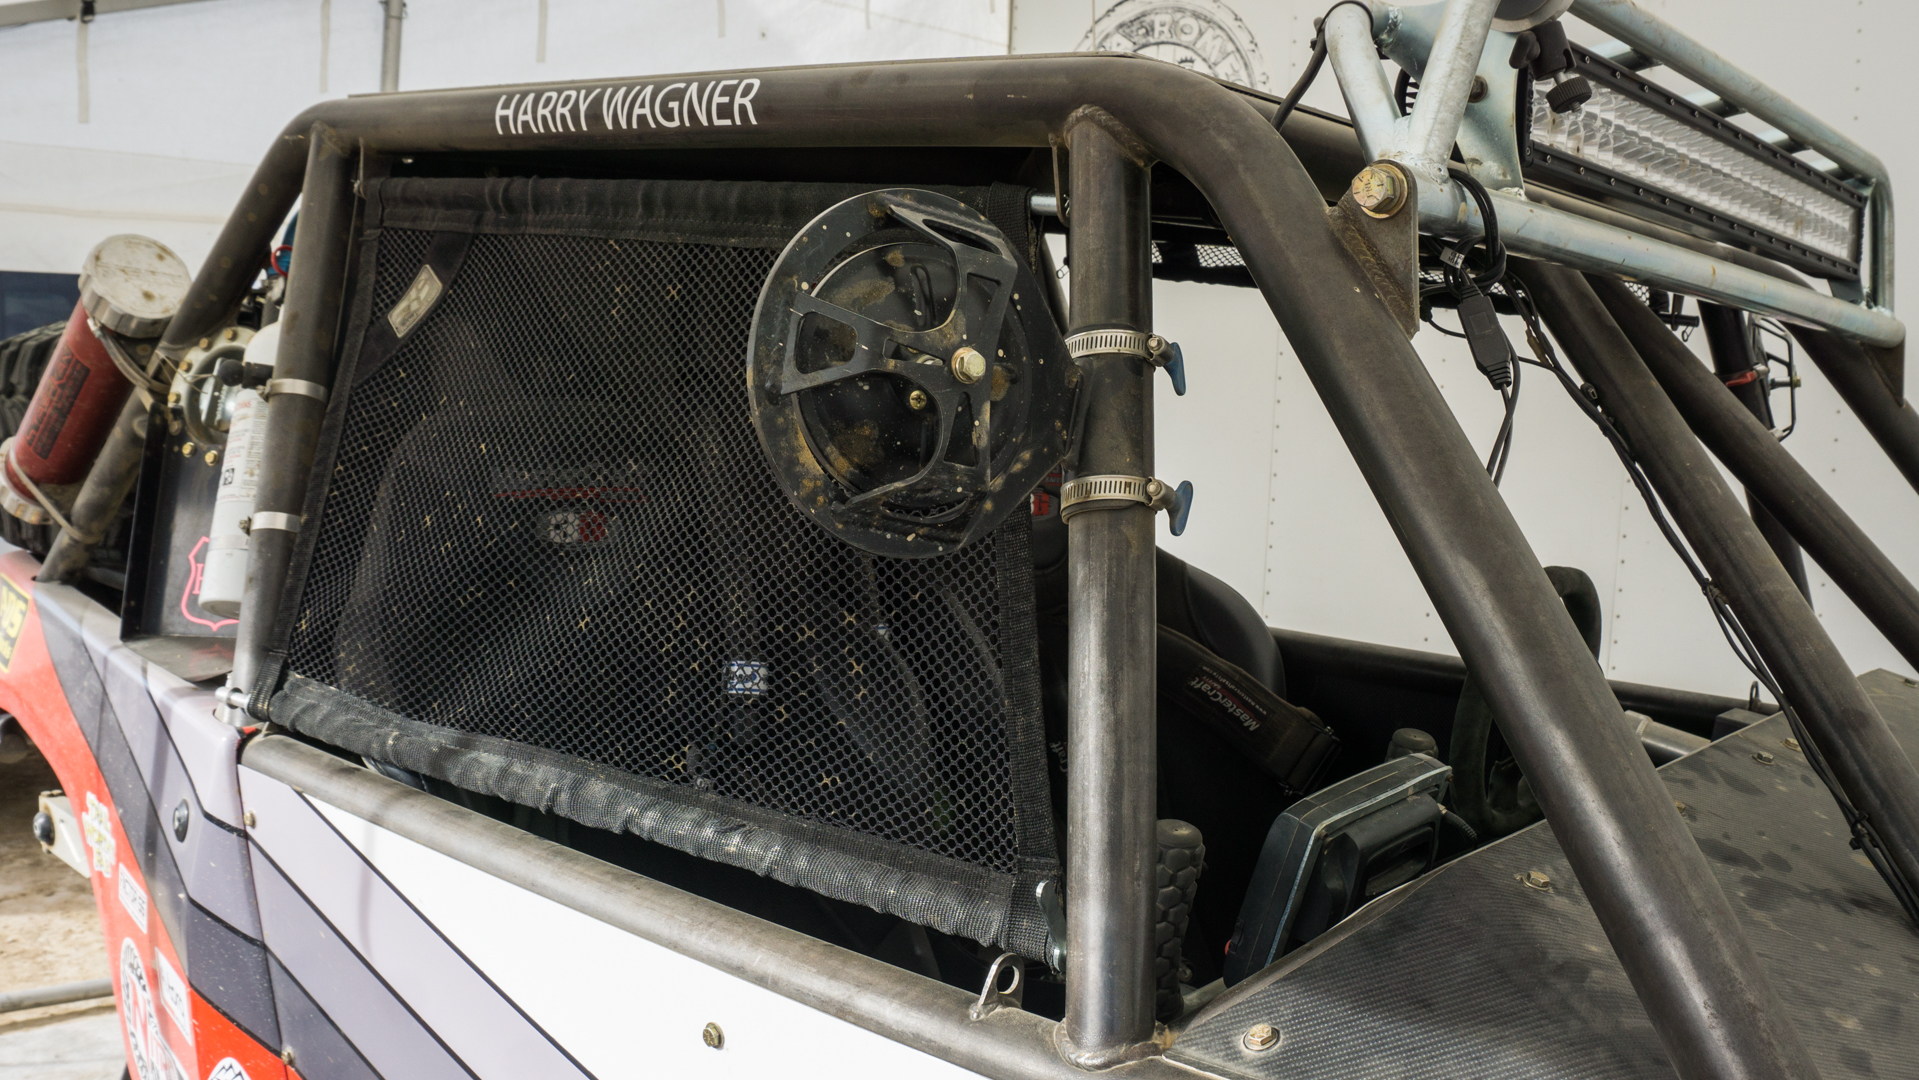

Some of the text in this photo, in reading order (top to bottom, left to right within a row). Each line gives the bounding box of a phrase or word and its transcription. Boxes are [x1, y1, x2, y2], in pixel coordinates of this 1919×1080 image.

[495, 78, 761, 135] HARRY WAGNER
[1189, 676, 1260, 732] MasterCraft
